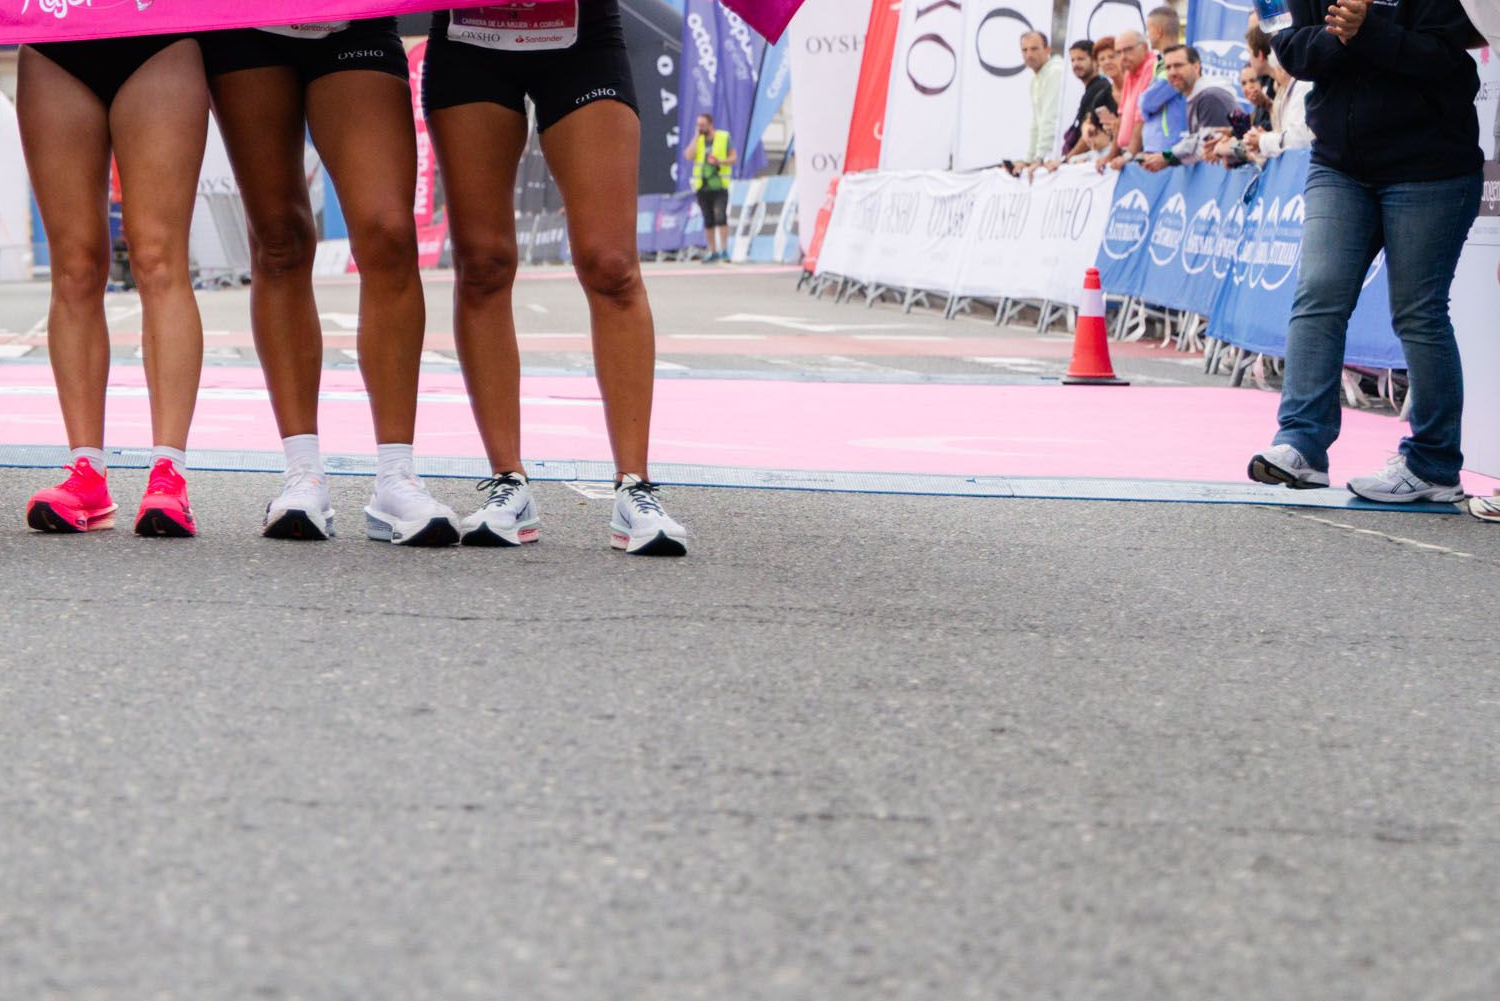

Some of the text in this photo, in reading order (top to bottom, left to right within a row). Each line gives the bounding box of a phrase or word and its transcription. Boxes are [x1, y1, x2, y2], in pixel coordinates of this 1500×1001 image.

[300, 23, 337, 32] Santander
[461, 18, 486, 26] CARRERA
[488, 19, 495, 27] DE
[506, 21, 528, 29] MUJER
[461, 30, 563, 43] OYSHO Santander
[338, 50, 384, 60] OYSHO
